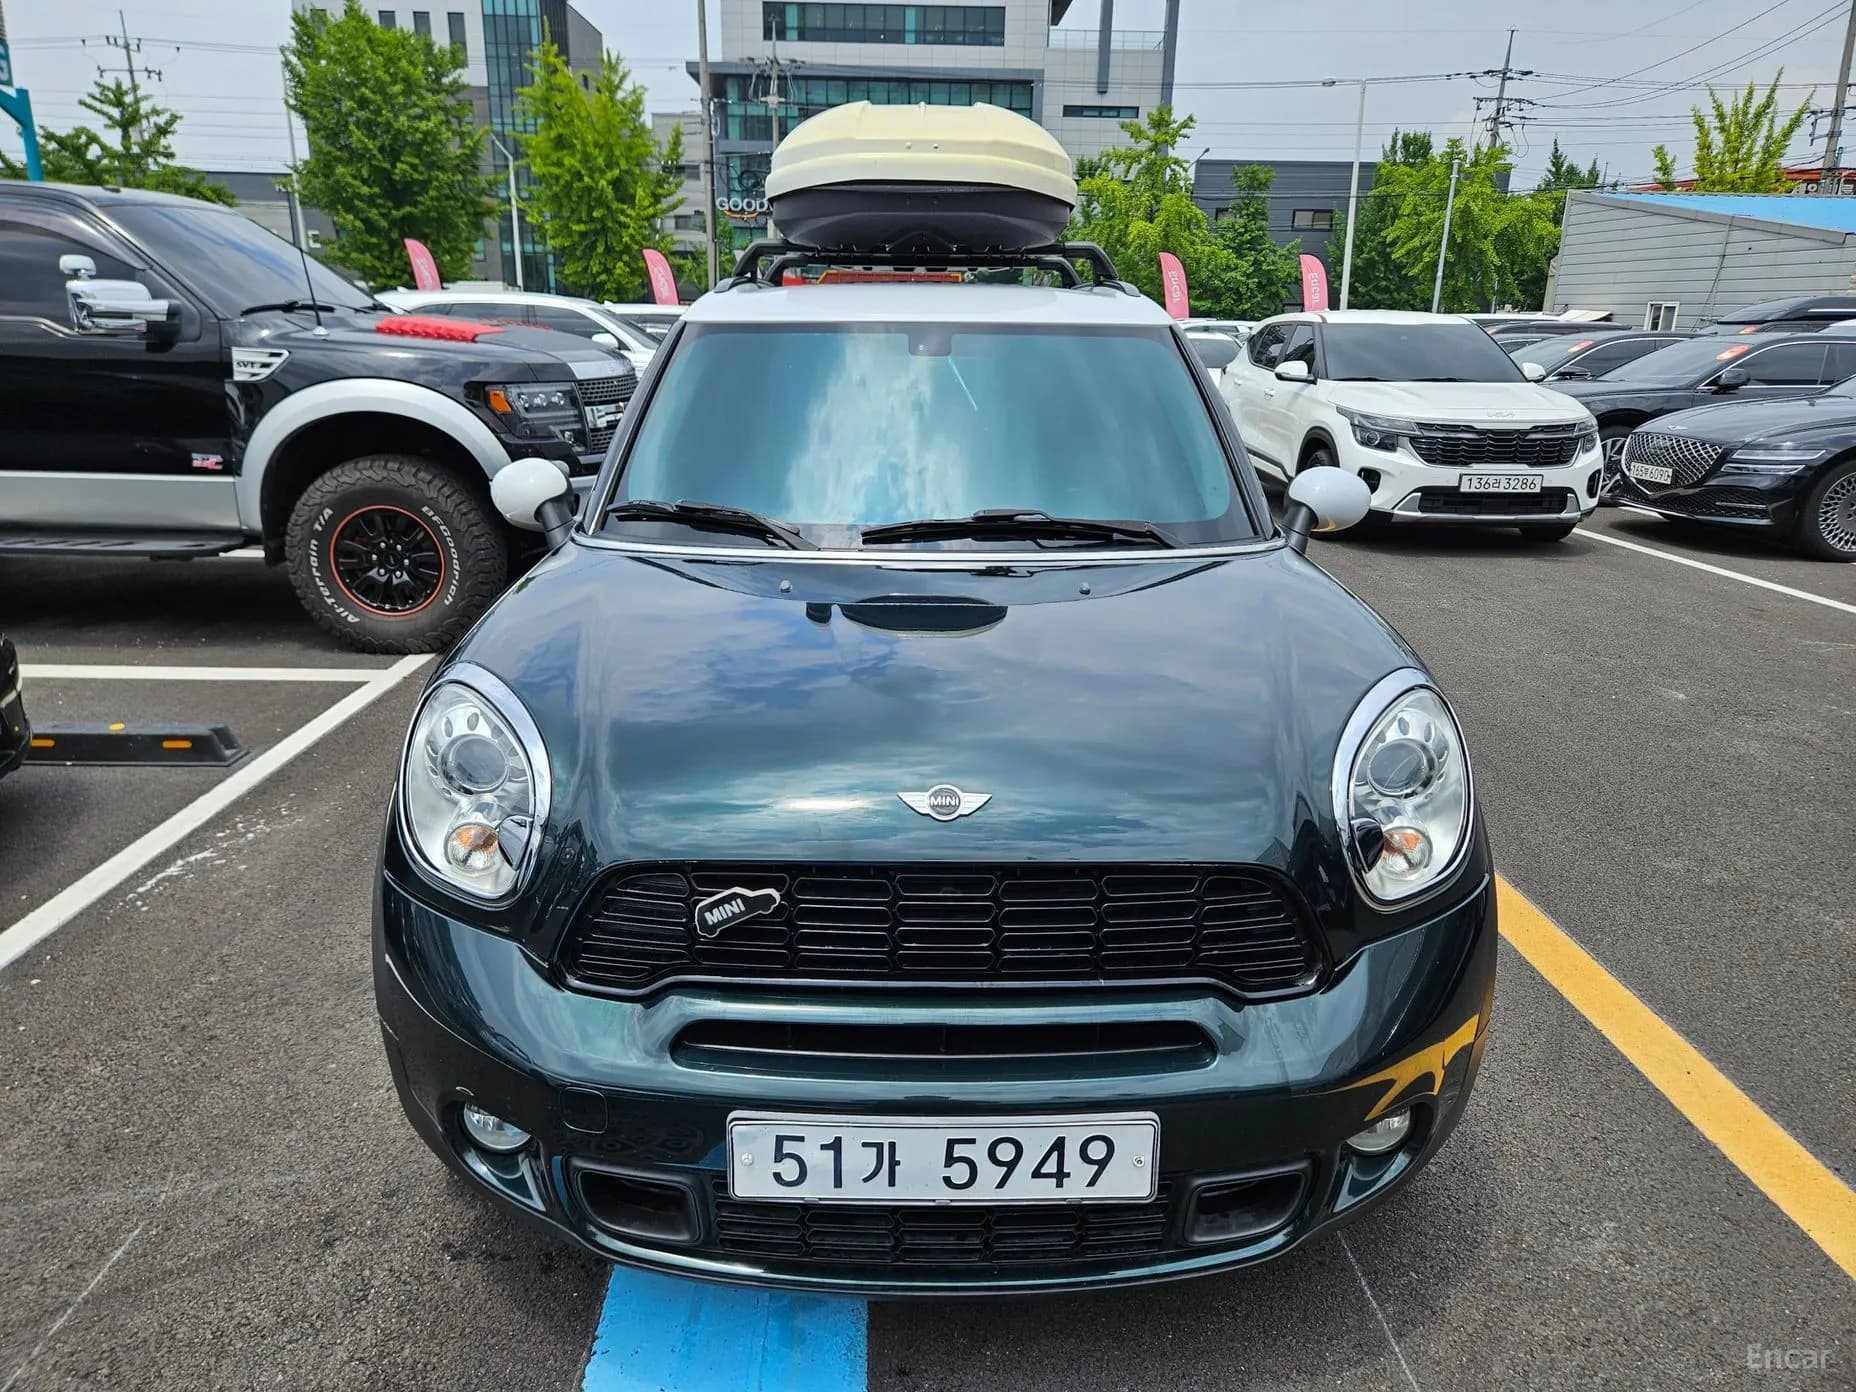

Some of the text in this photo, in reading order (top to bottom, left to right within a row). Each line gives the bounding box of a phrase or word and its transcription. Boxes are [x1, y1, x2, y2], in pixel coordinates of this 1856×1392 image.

[716, 197, 773, 212] GOOD
[1467, 477, 1537, 490] 136라 3286
[421, 505, 460, 605] BFGoodrich
[930, 795, 960, 807] MINI
[703, 898, 746, 925] MINI
[772, 1134, 1116, 1190] 51가 5949
